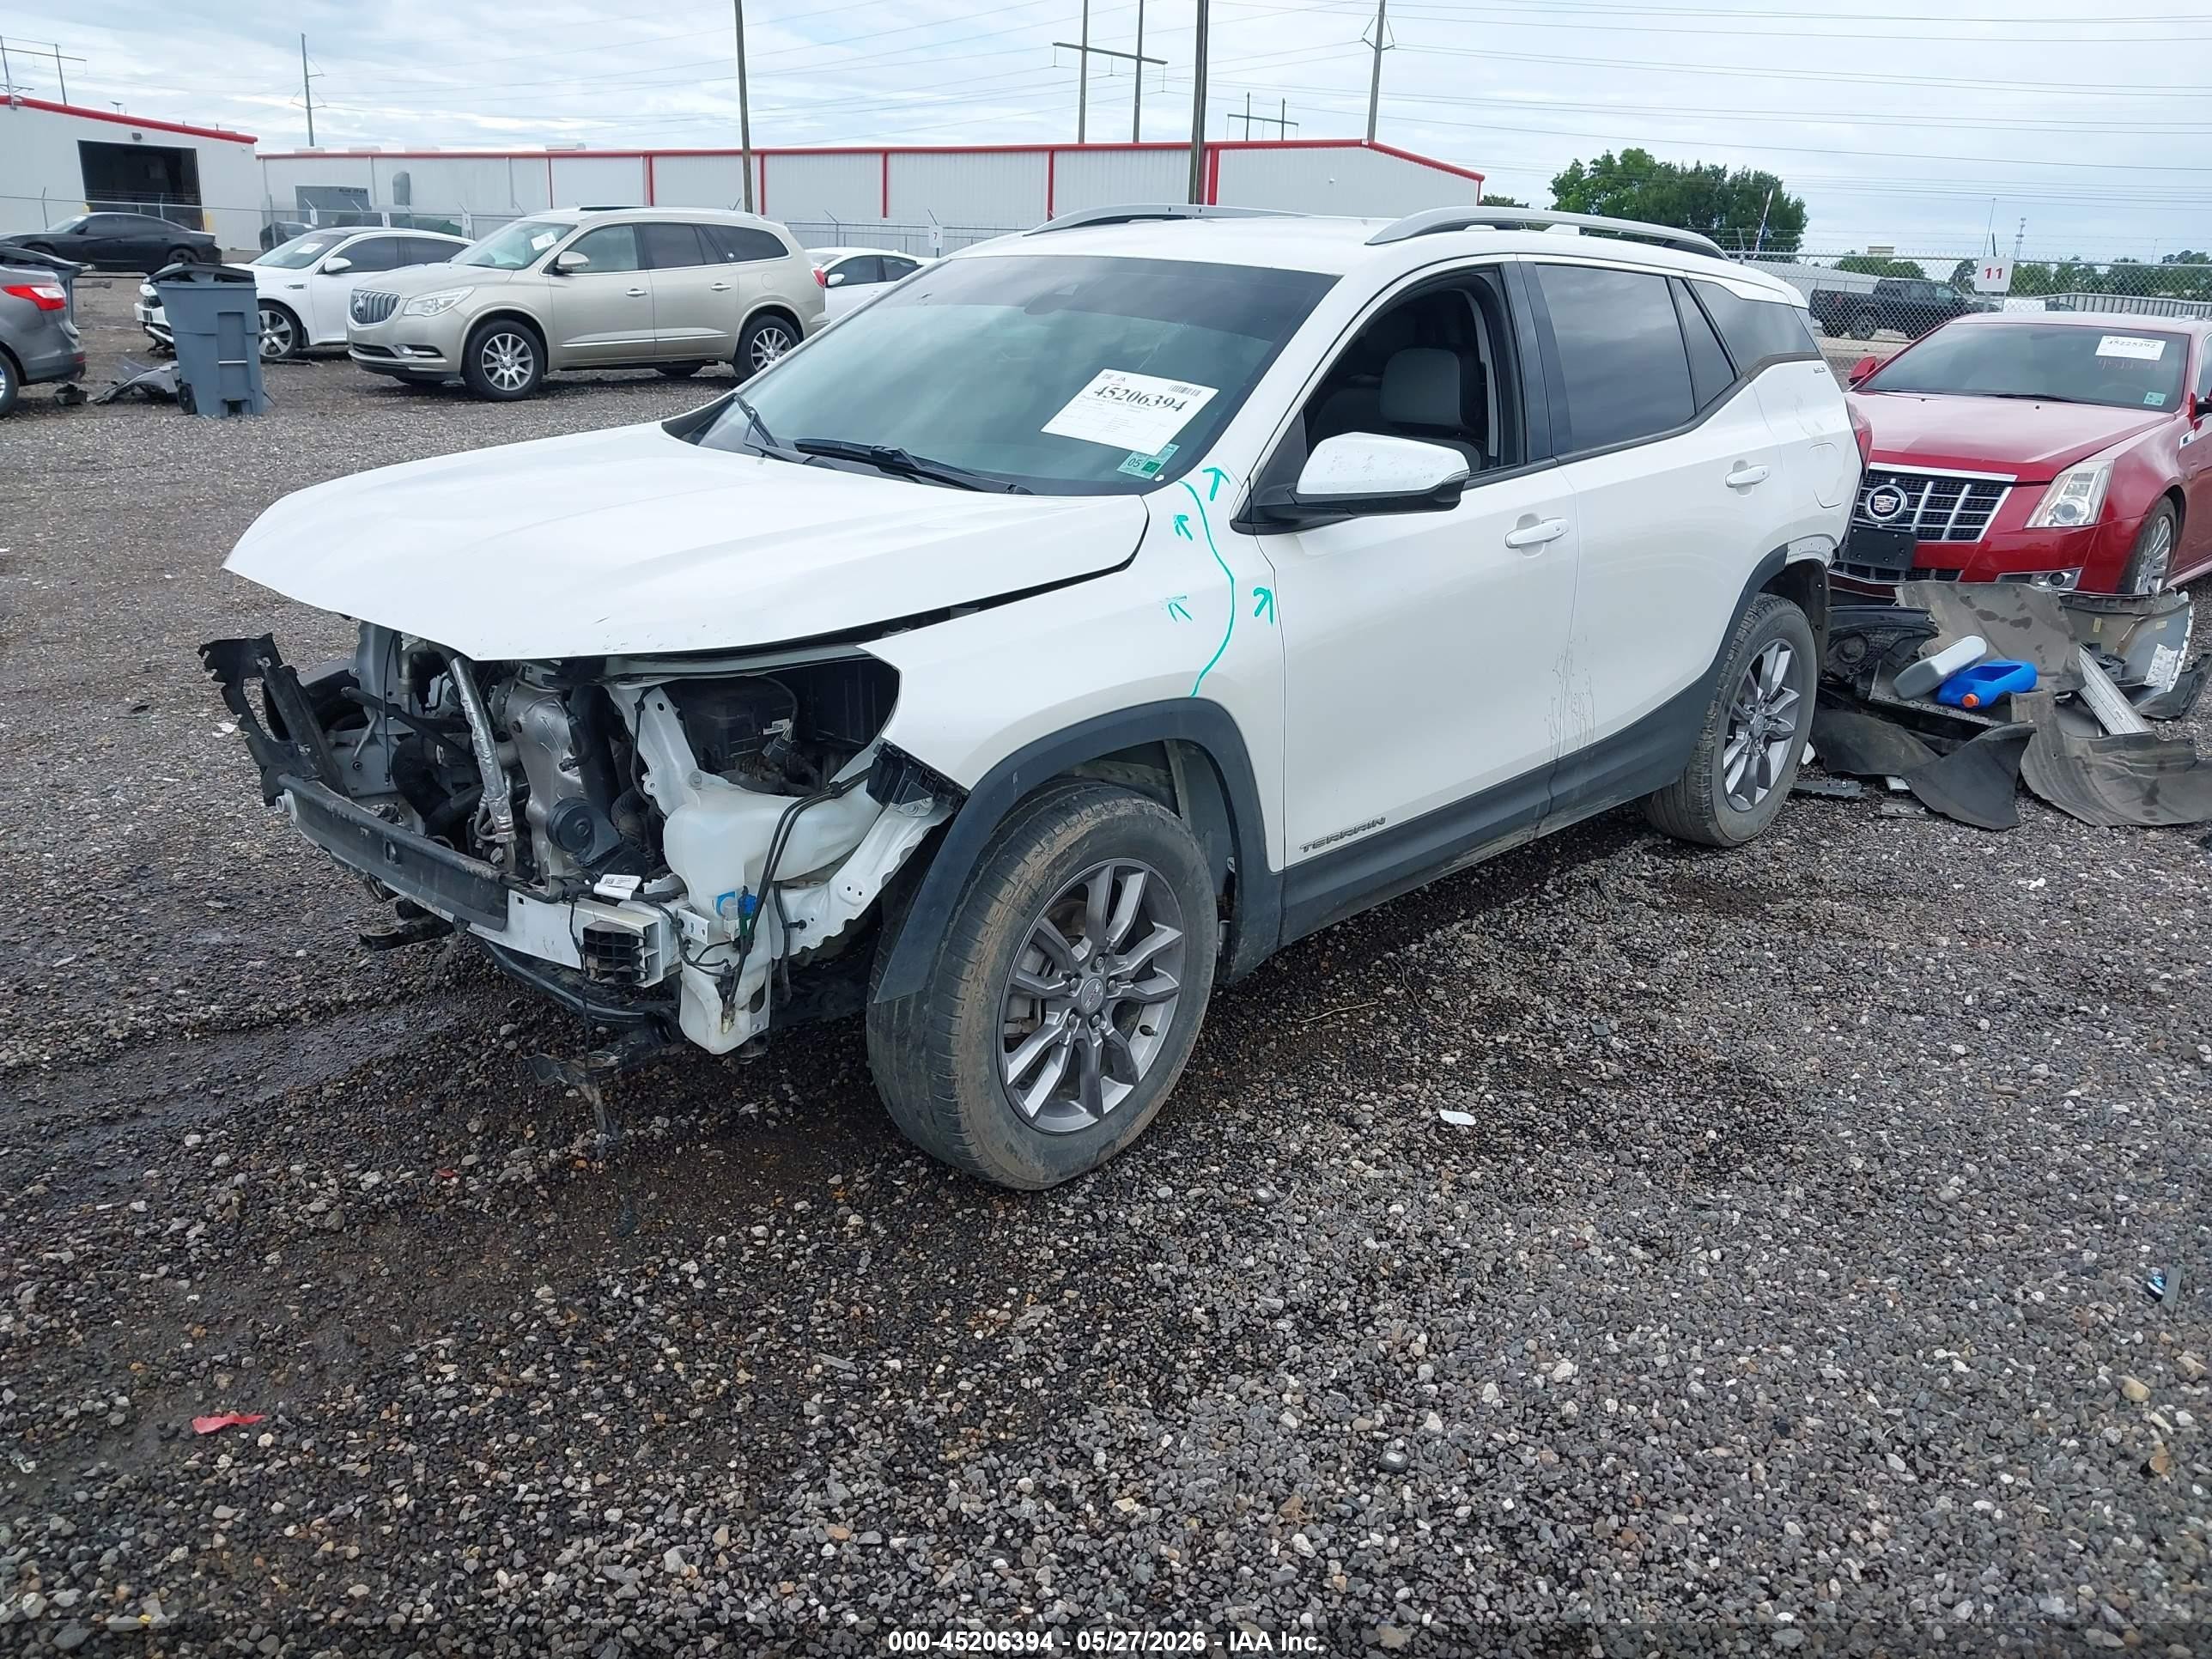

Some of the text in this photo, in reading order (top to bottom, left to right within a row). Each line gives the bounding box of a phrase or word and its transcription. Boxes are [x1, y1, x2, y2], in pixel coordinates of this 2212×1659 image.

[933, 232, 938, 240] 7
[1984, 267, 2003, 280] 11
[1093, 386, 1188, 412] 45206394
[1127, 458, 1142, 468] 05
[1298, 817, 1386, 853] TERRAIN
